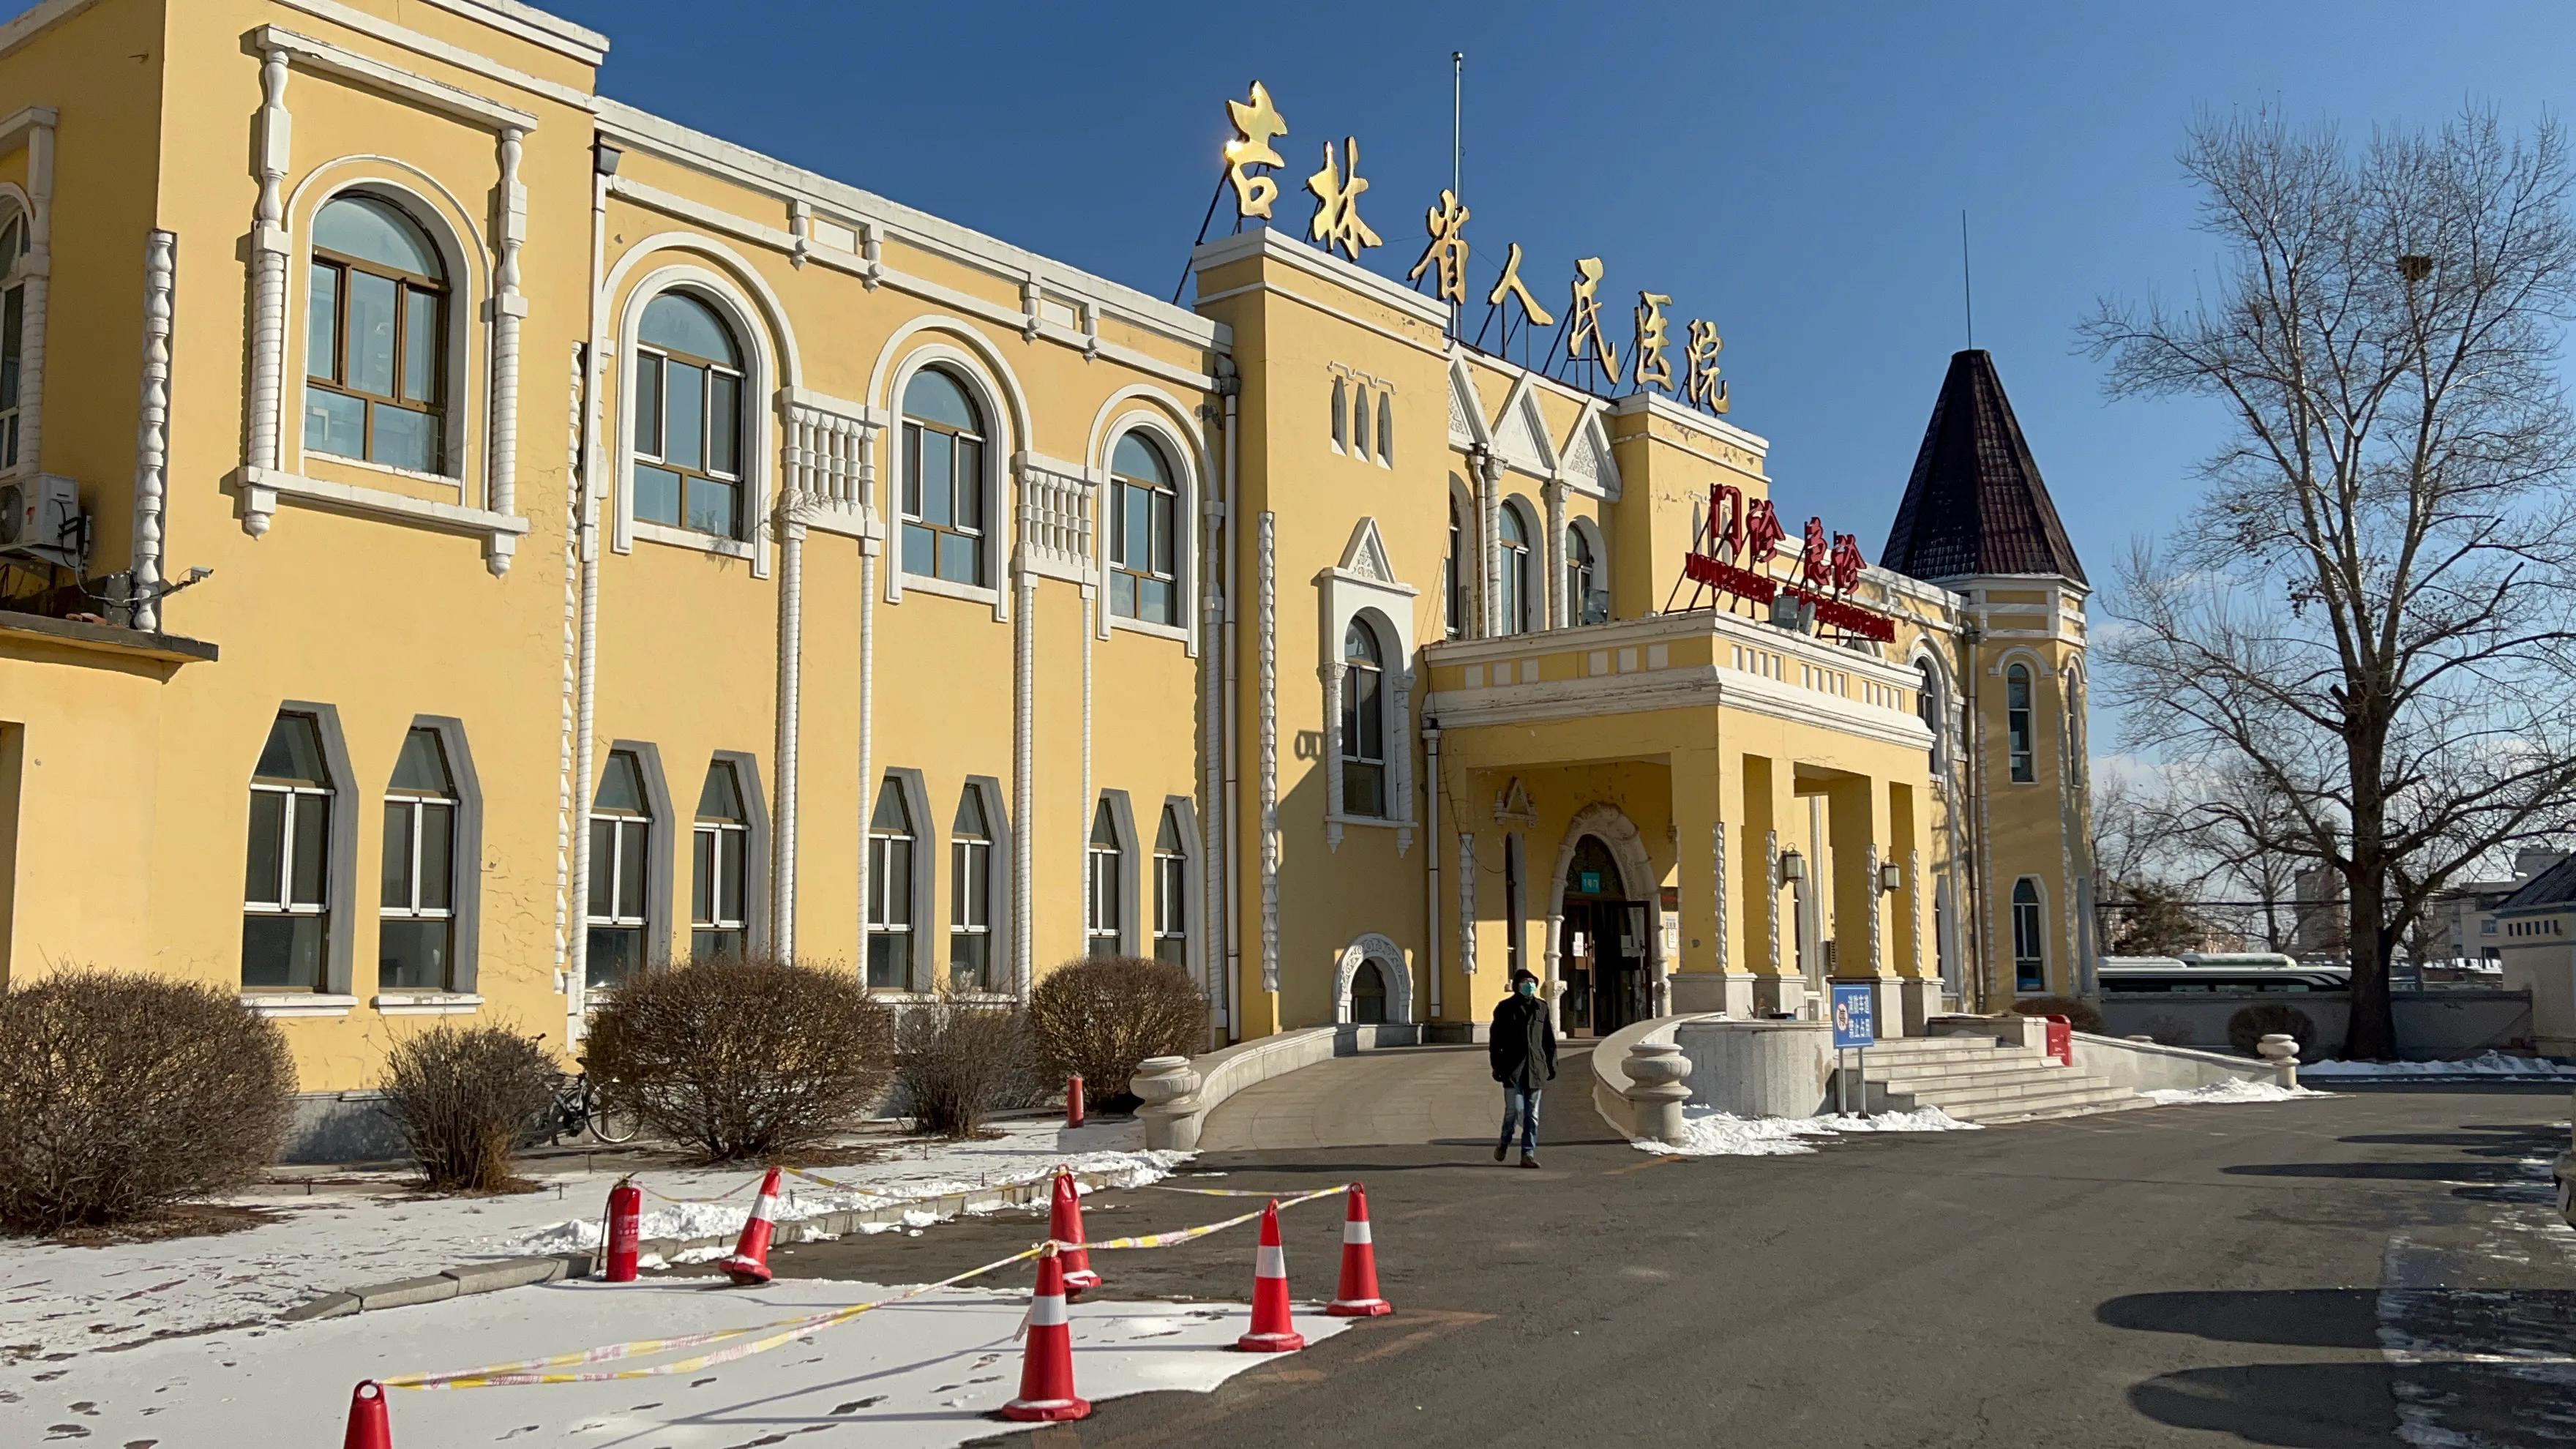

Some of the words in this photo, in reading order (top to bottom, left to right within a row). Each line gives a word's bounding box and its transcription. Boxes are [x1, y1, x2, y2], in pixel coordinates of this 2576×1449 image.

[1224, 80, 1730, 414] 吉林省人民医院
[1711, 483, 1786, 564] 门诊
[1803, 516, 1868, 596] 急诊
